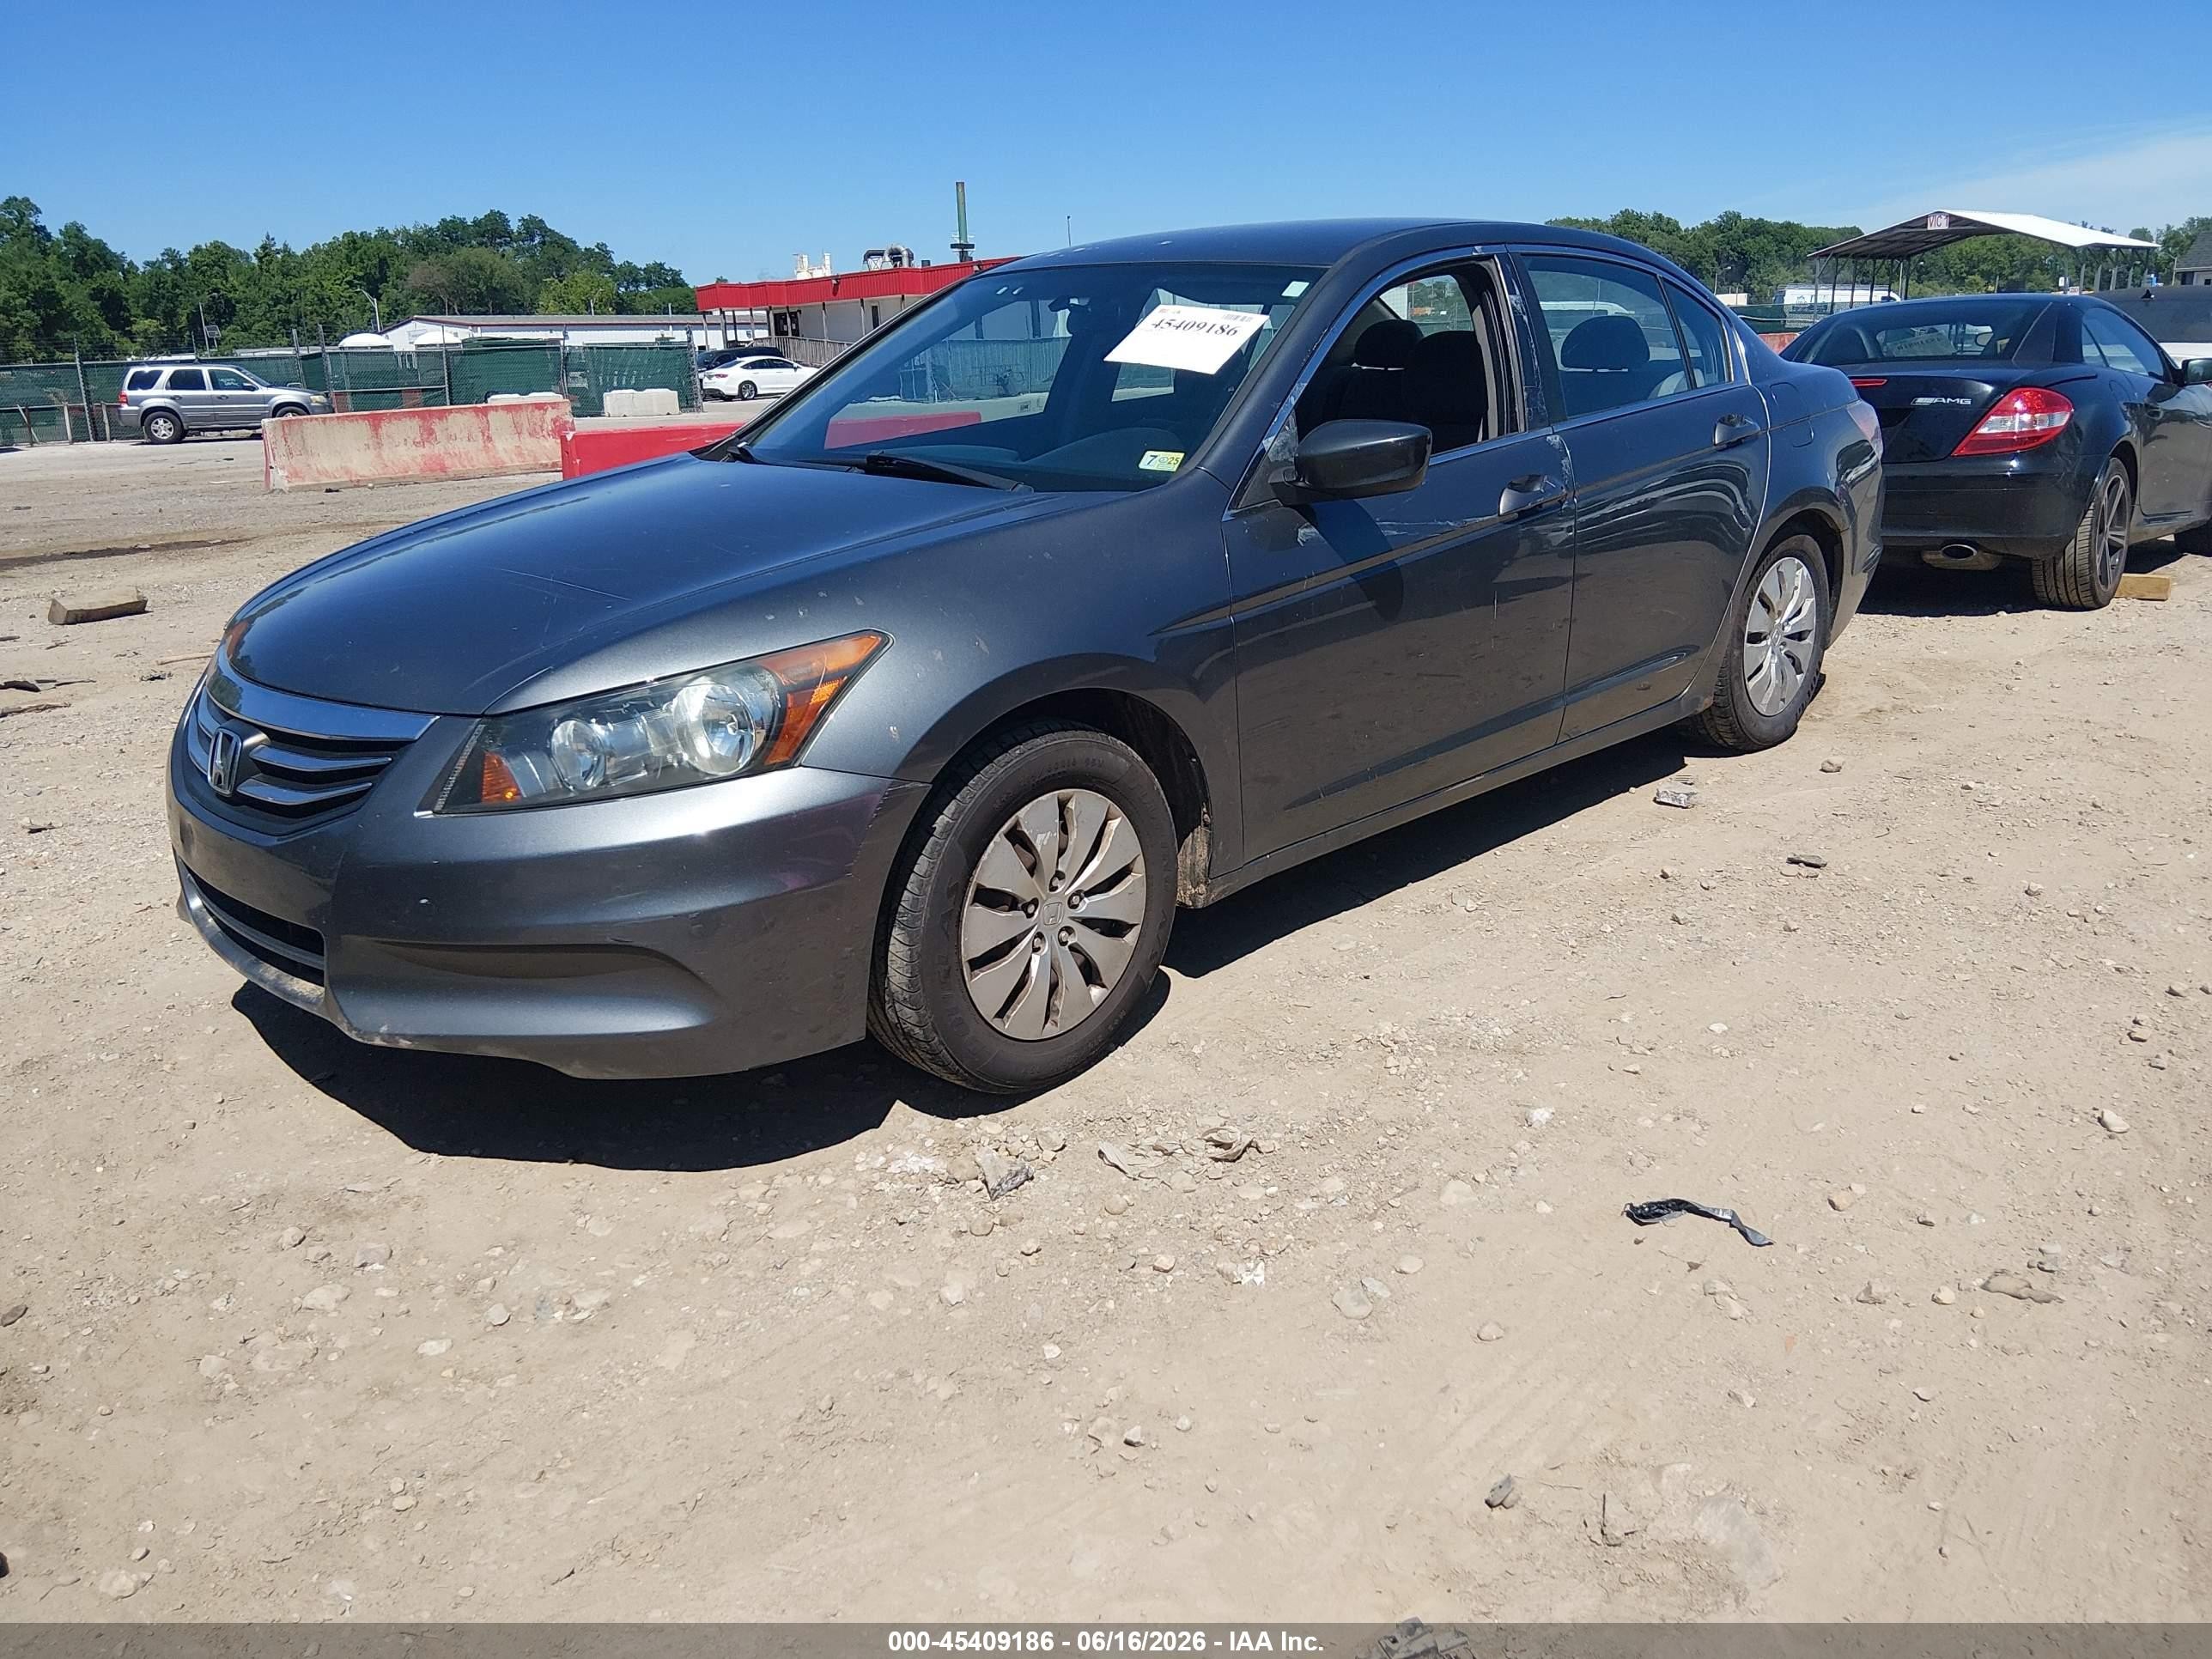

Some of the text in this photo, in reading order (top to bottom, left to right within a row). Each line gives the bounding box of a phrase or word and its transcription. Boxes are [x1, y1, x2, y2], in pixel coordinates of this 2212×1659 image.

[1152, 318, 1241, 337] 45409186
[1933, 397, 1972, 405] AMG
[1146, 454, 1158, 465] 7
[1168, 456, 1181, 465] 25
